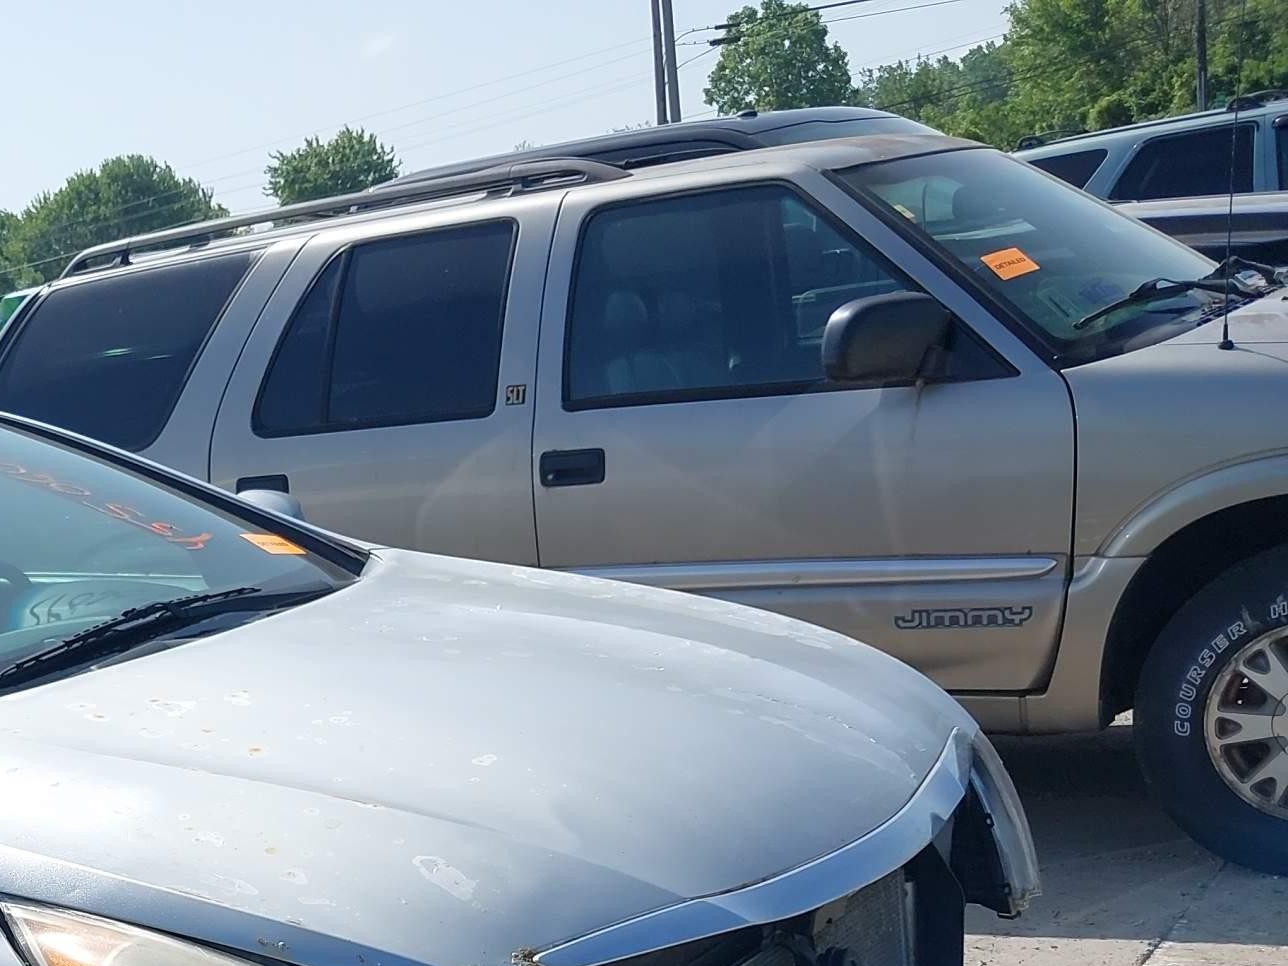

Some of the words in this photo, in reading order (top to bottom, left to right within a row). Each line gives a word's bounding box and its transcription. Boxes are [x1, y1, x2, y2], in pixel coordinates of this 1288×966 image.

[993, 257, 1027, 270] DETAILED
[506, 385, 525, 405] SLT
[1174, 620, 1248, 737] COURSER
